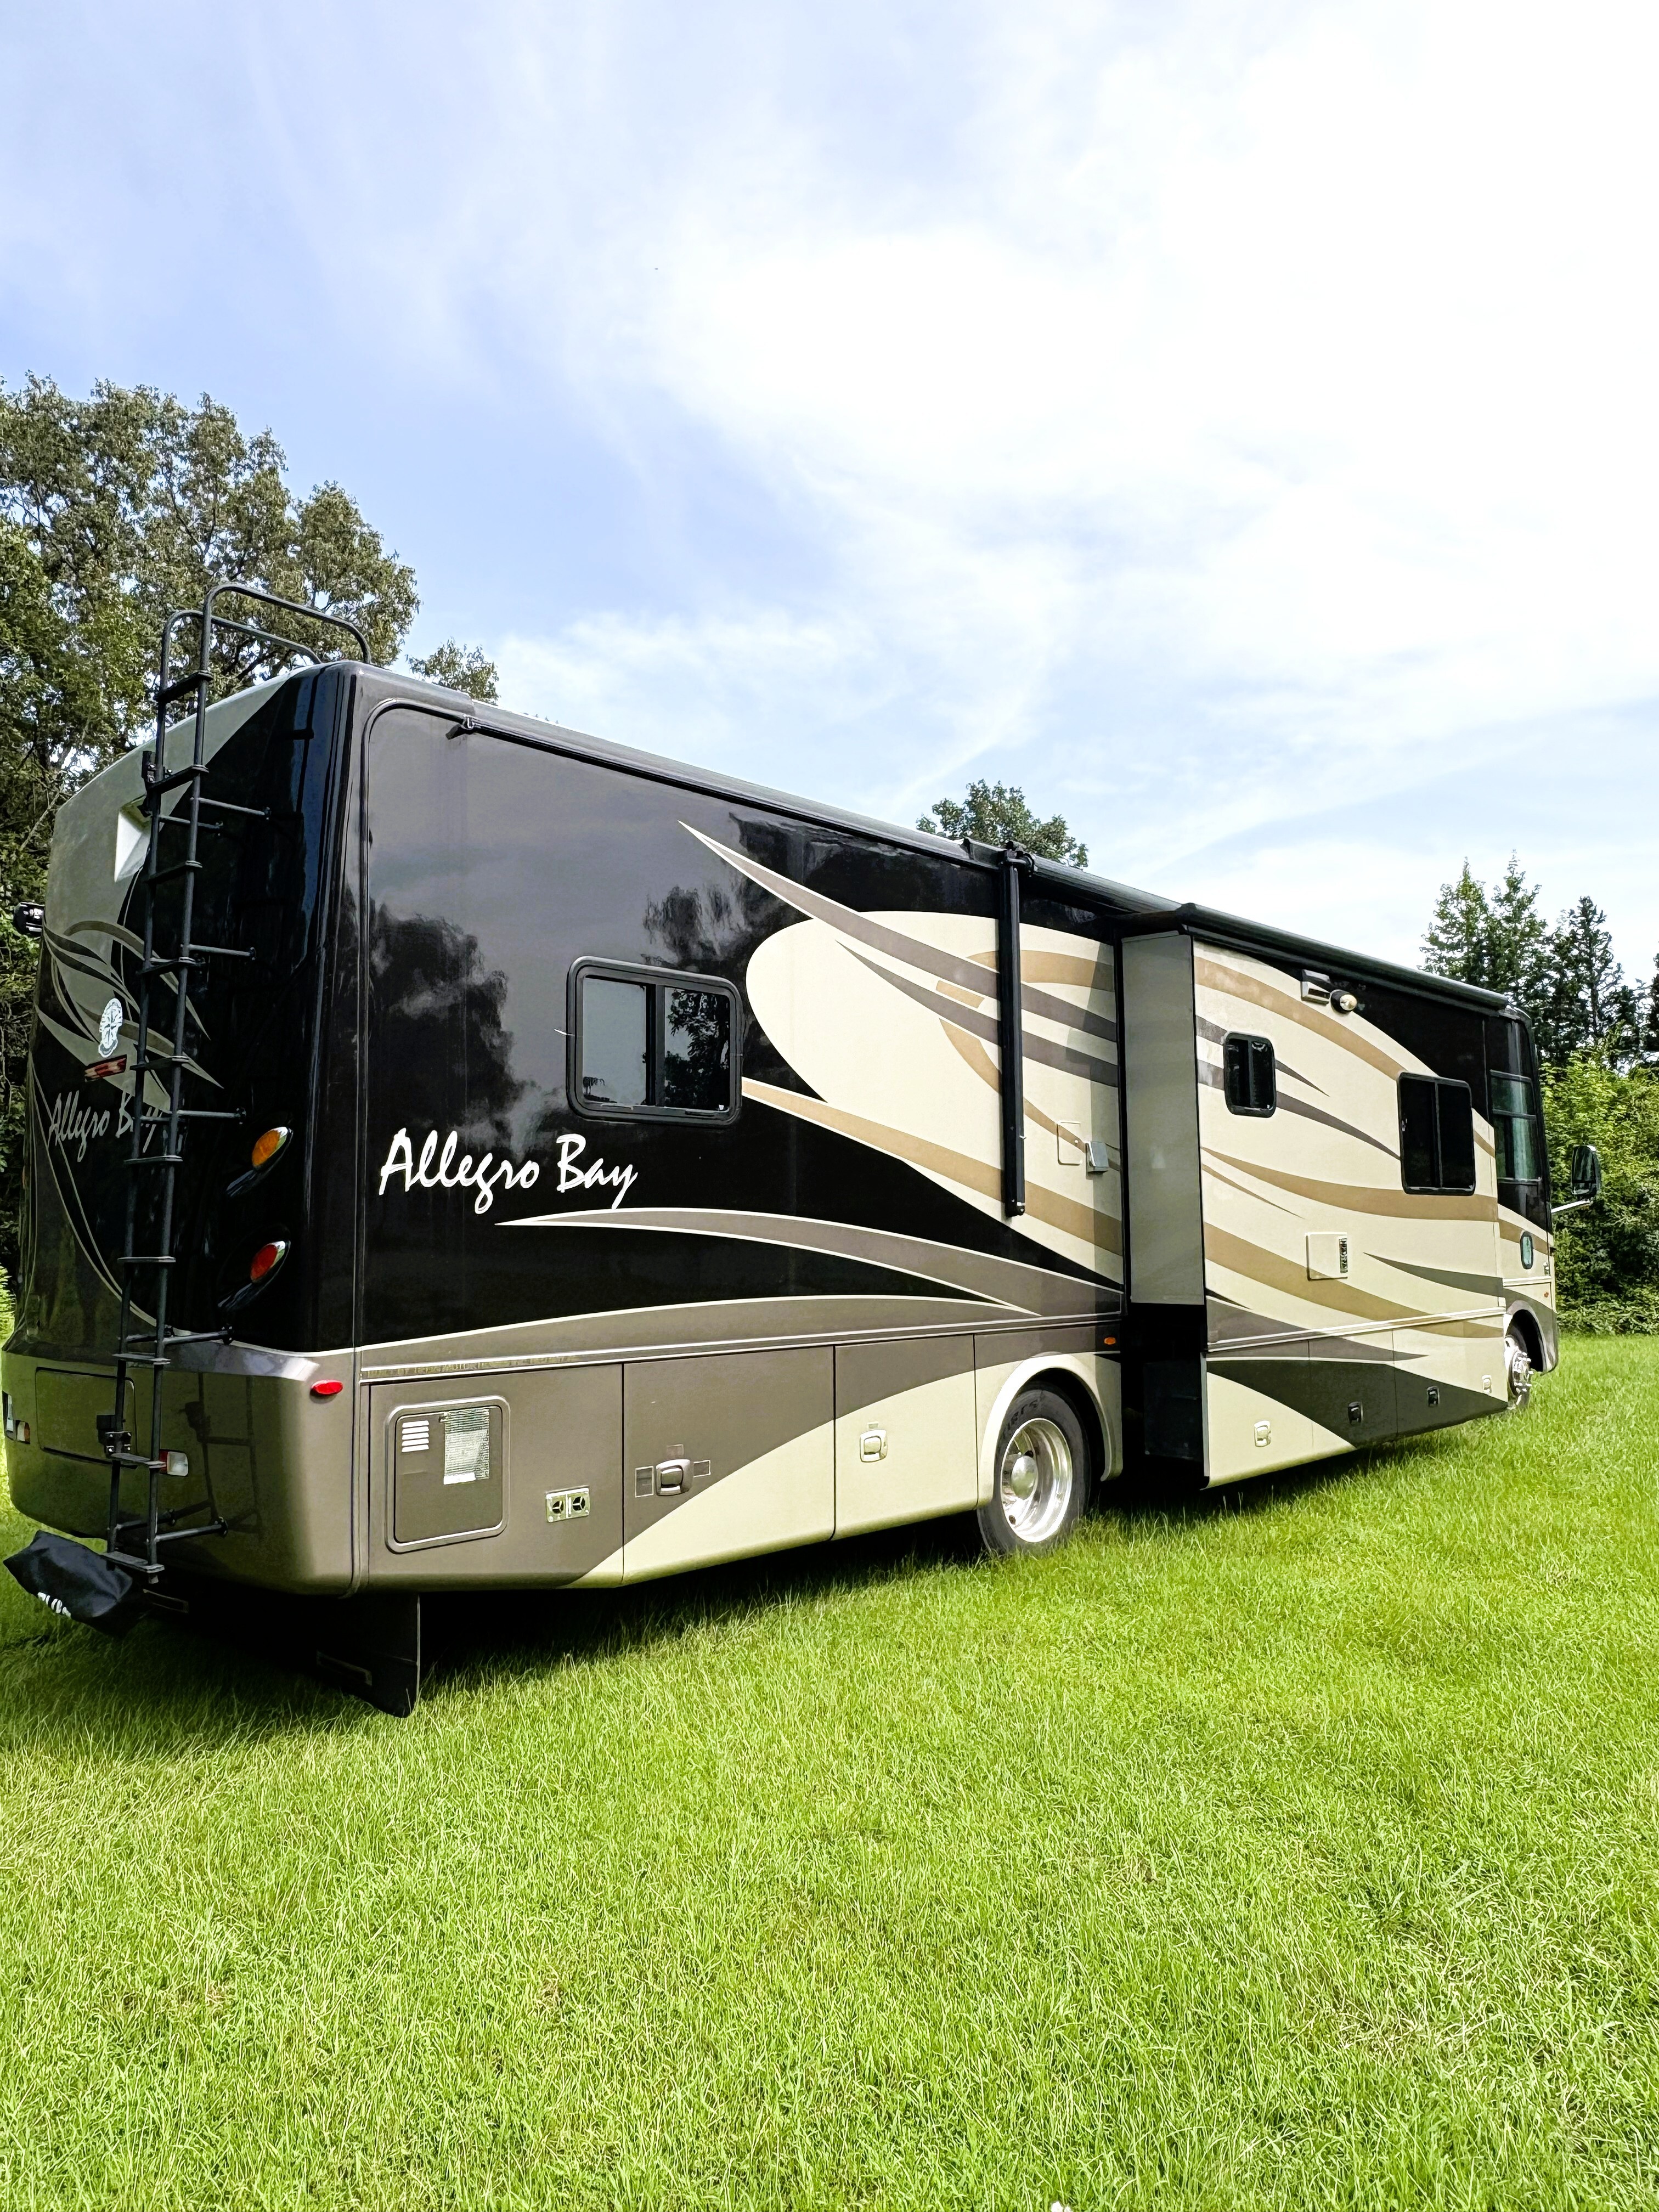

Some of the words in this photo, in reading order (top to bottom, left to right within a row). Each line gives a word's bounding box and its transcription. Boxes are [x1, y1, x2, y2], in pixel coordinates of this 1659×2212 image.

[47, 1089, 110, 1163] Allegro
[379, 1127, 540, 1215] Allegro
[556, 1133, 639, 1210] Bay
